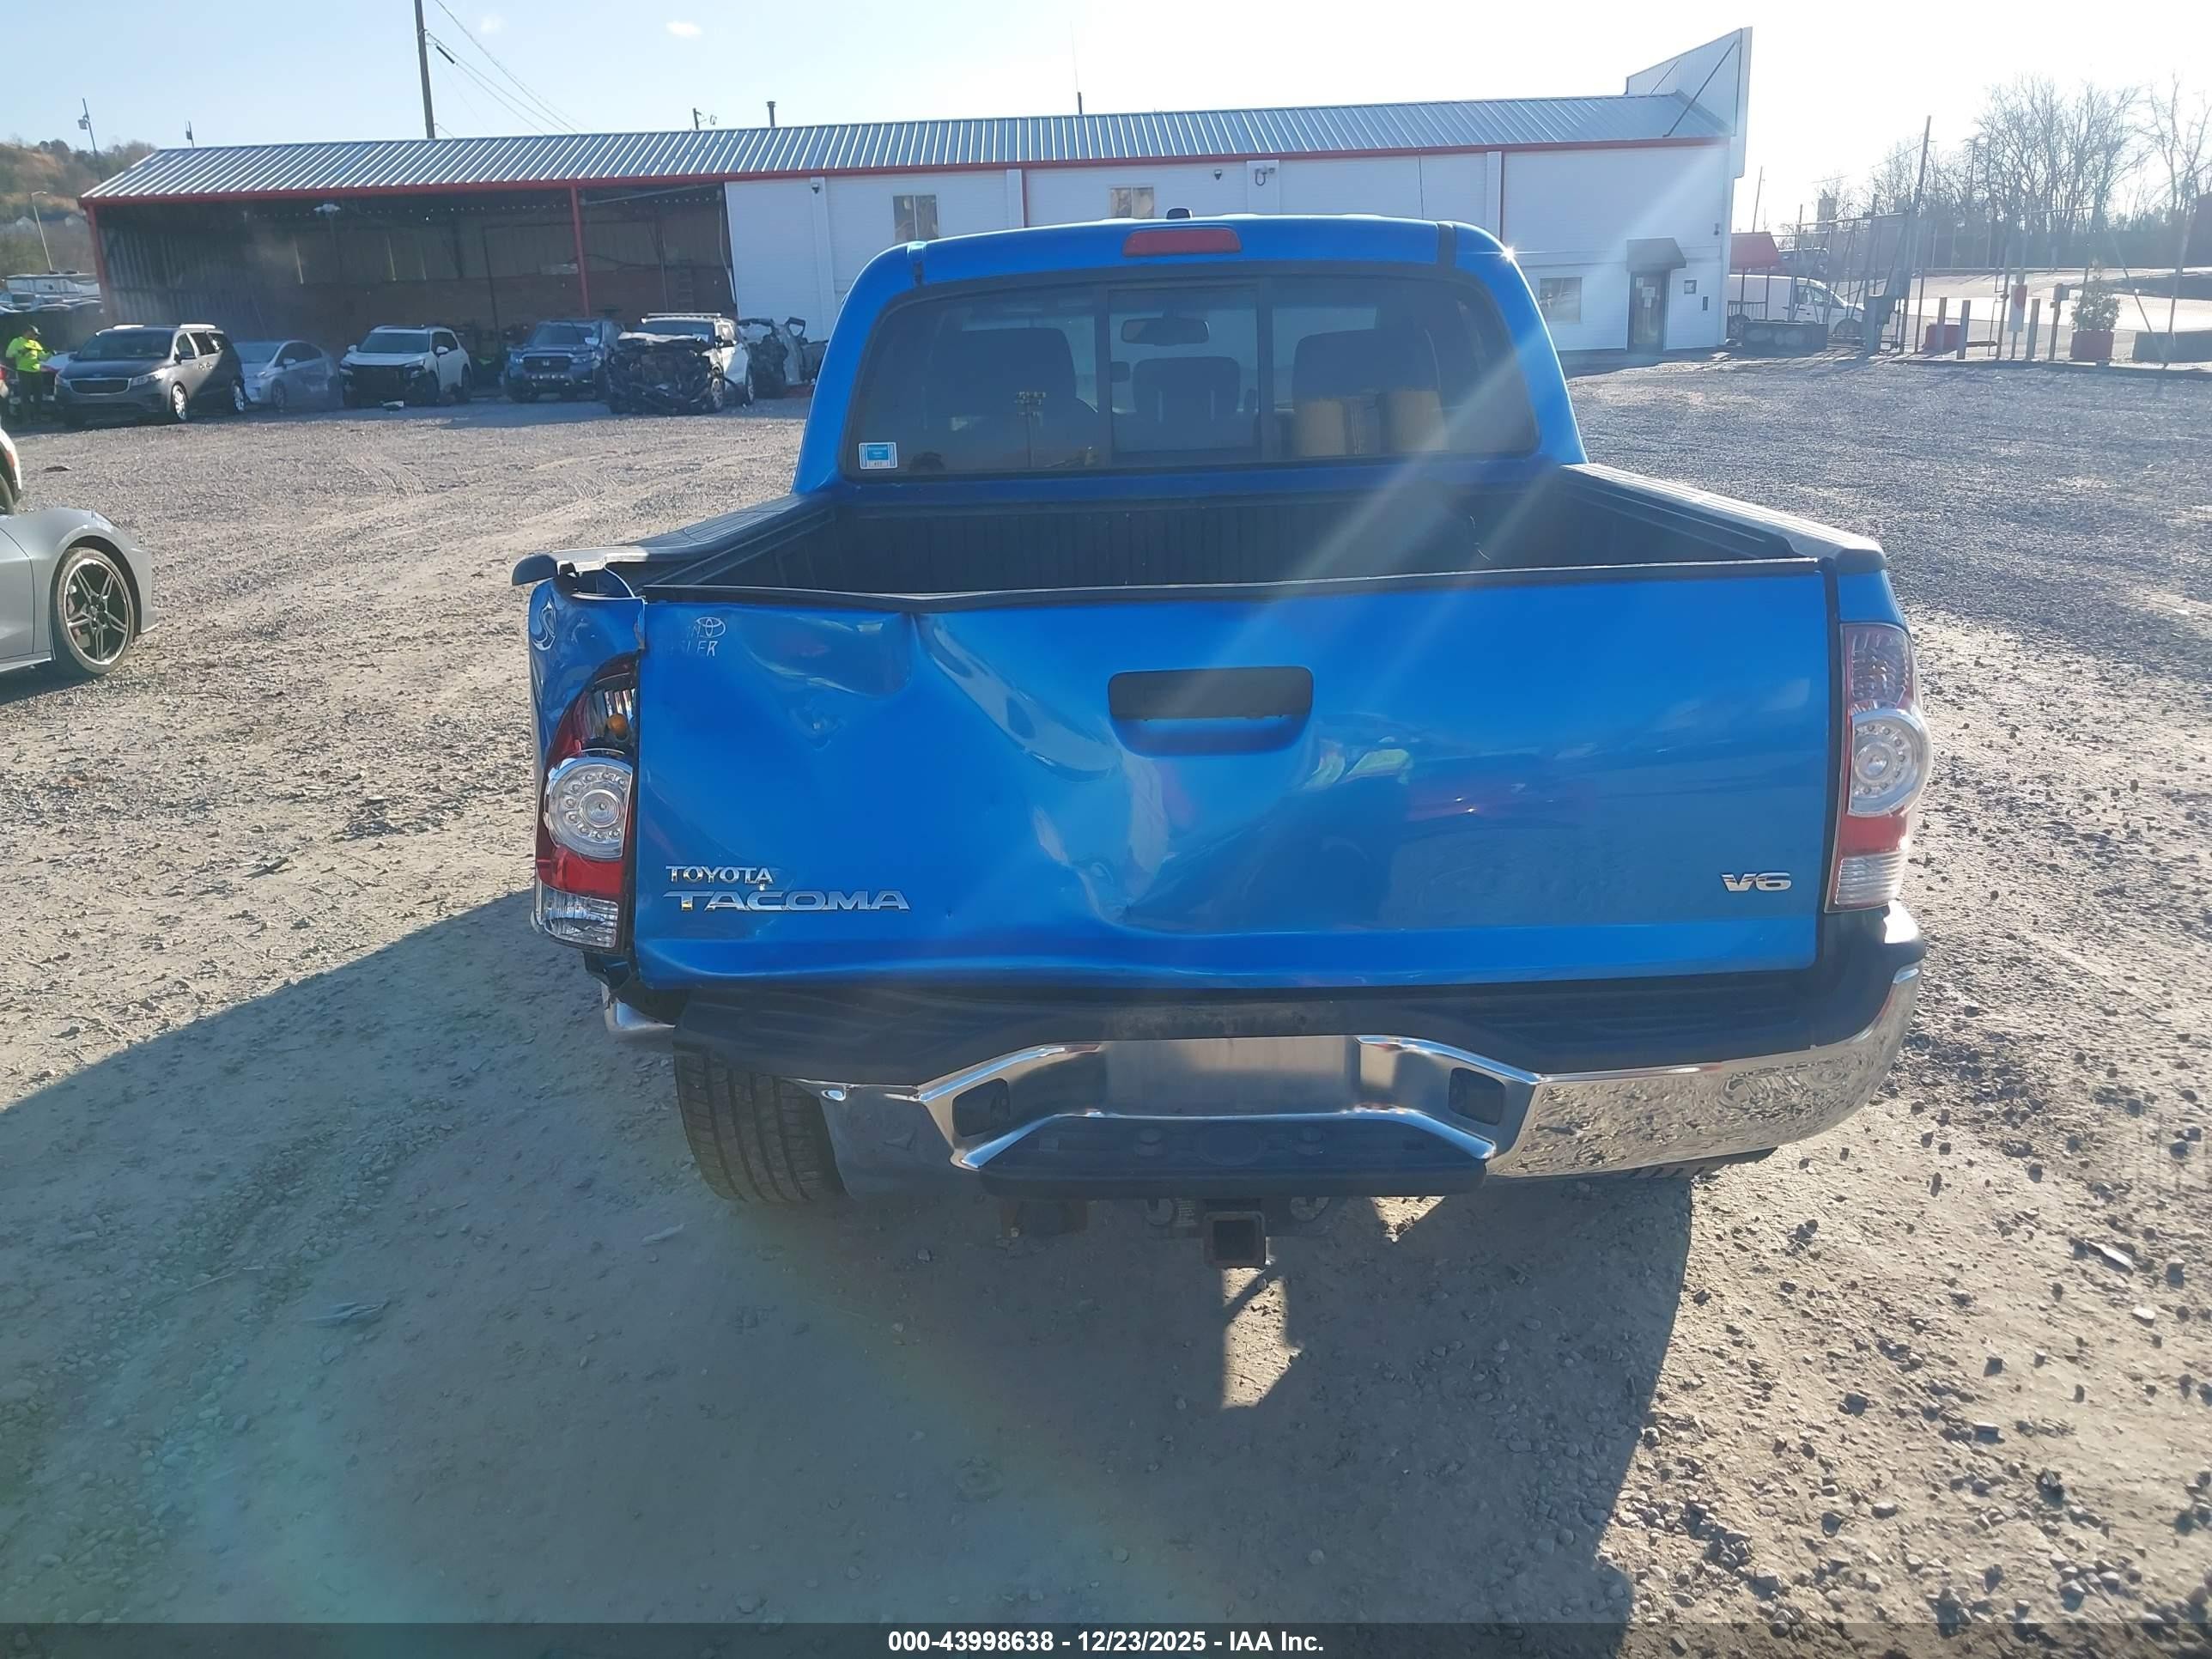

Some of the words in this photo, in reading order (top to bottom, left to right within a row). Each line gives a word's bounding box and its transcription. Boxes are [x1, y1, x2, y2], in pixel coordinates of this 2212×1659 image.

[665, 865, 773, 884] TOYOTA
[1721, 872, 1792, 892] V6
[663, 890, 910, 912] TACOMA
